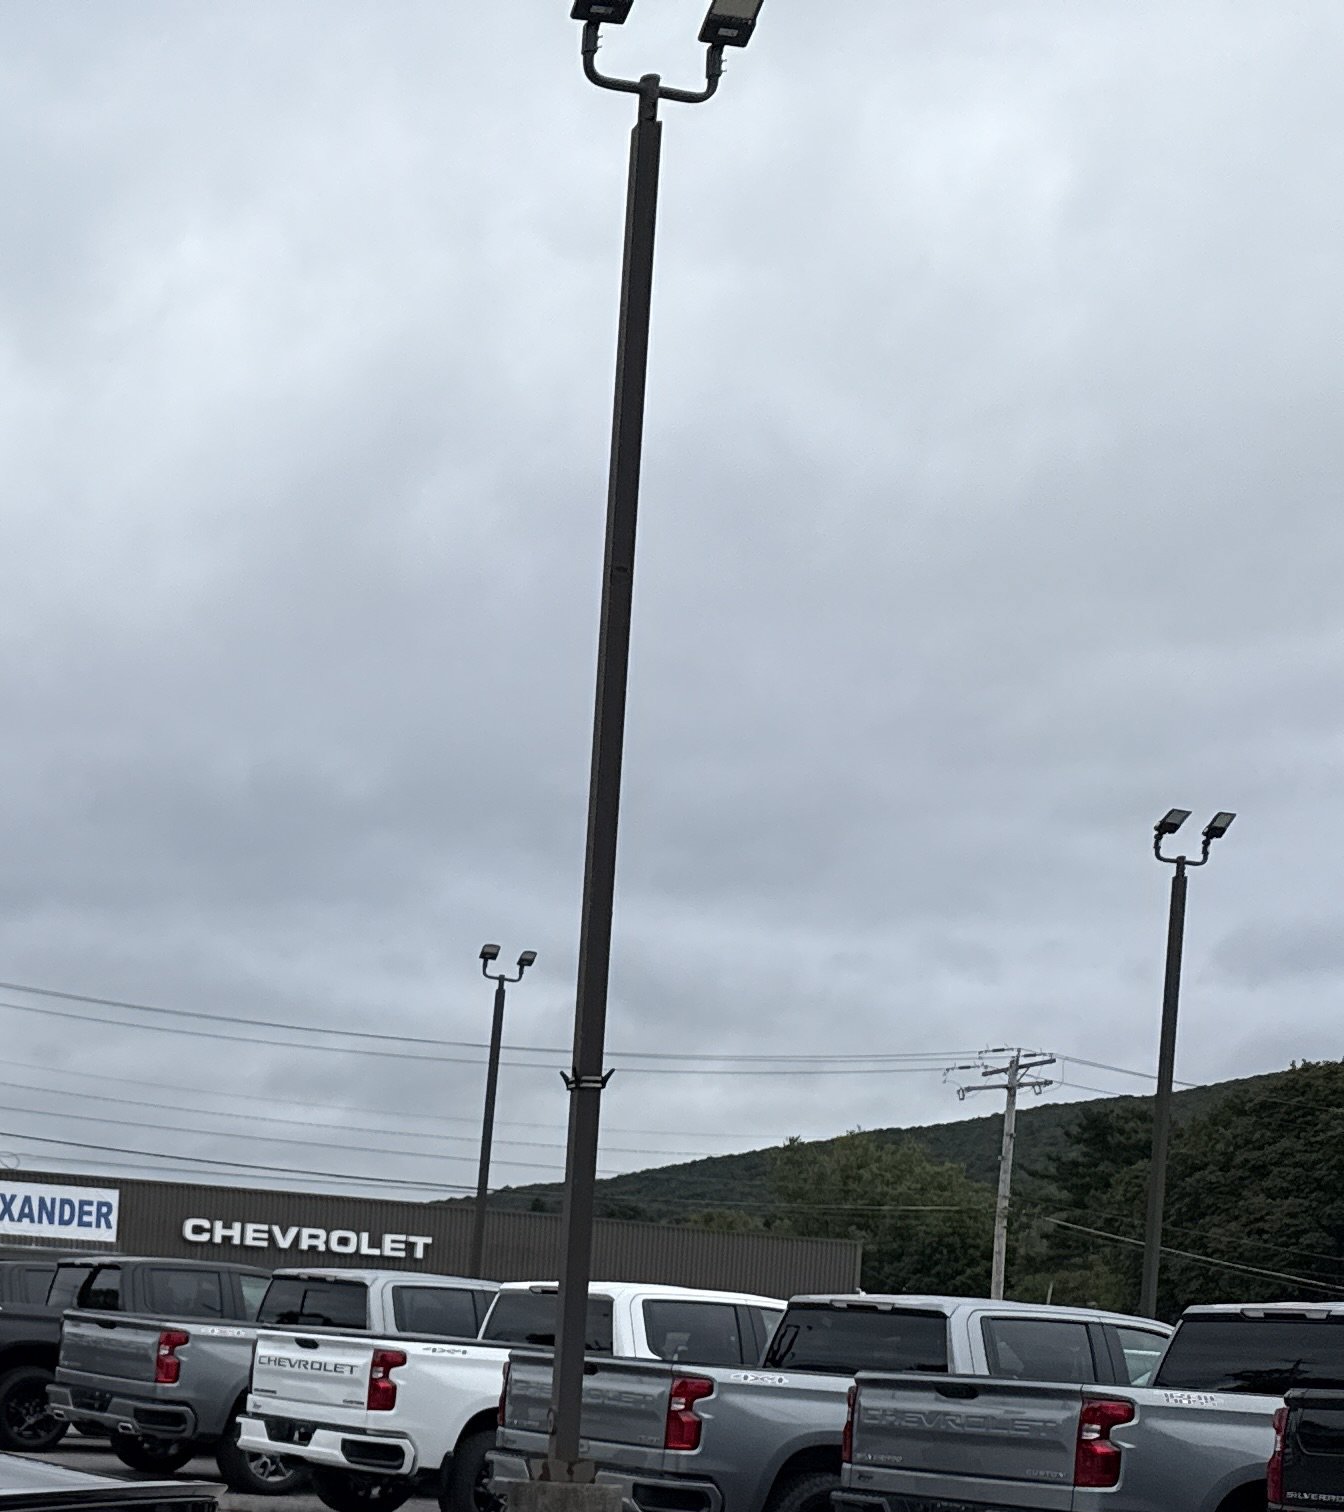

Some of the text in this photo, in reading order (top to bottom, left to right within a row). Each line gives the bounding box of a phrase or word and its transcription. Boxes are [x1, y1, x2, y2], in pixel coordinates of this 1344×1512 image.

[182, 1217, 433, 1259] CHEVROLET
[258, 1355, 359, 1375] CHEVROLET
[862, 1406, 1059, 1437] CHEVROLET
